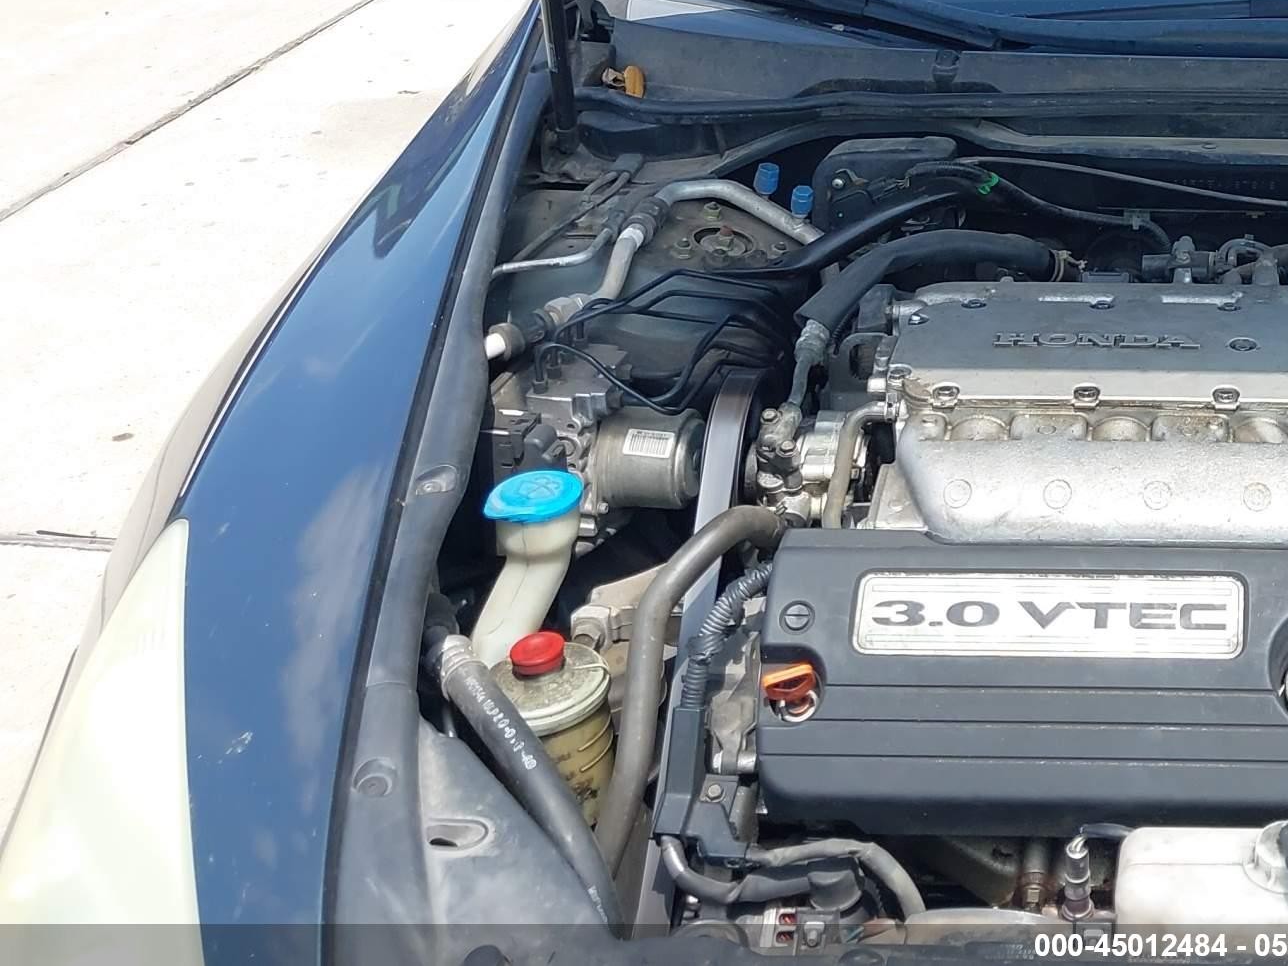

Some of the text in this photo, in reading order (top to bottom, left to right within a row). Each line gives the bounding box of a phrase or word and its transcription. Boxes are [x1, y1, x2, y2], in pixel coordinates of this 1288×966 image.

[992, 332, 1201, 350] HONDA
[872, 599, 1228, 631] 3.0 VTEC
